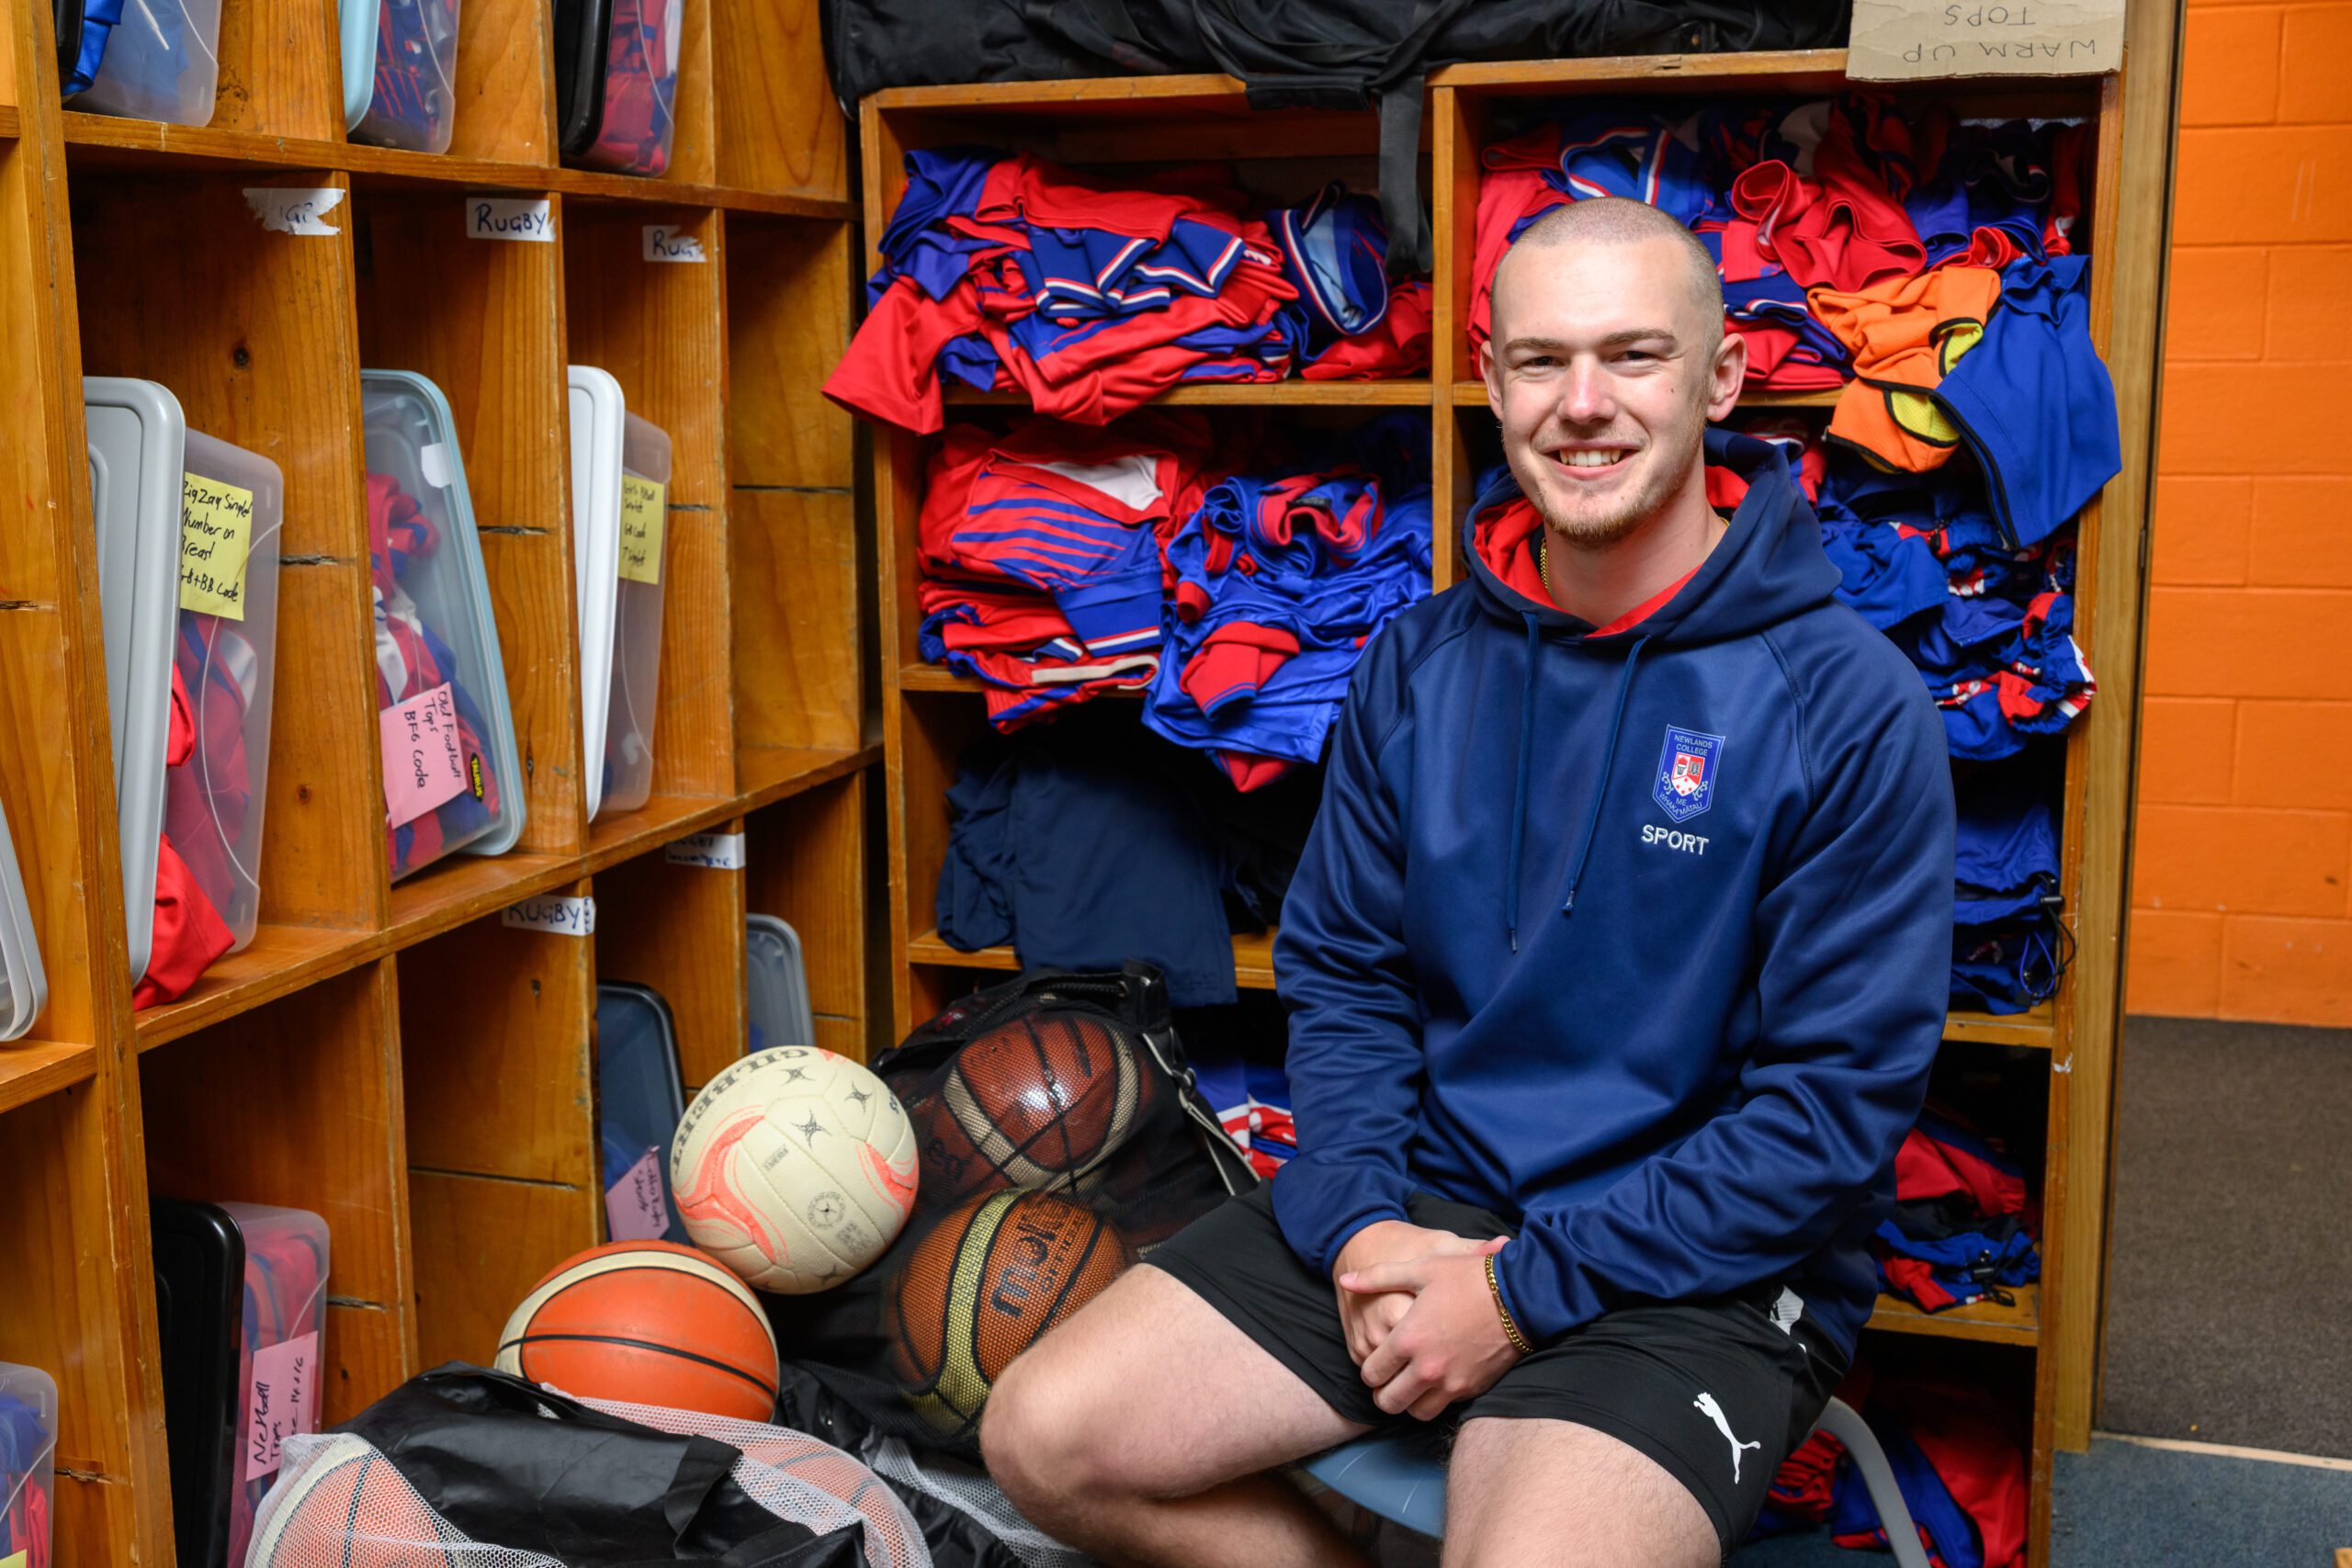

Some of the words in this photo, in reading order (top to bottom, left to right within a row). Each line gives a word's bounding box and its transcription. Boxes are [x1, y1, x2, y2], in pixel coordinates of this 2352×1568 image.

[1944, 6, 2036, 27] TOPS
[1903, 43, 1956, 63] UP
[1979, 39, 2096, 60] WARM
[183, 507, 222, 536] Number
[222, 529, 235, 540] on
[422, 697, 439, 733] Tops
[437, 691, 452, 717] Old
[1674, 735, 1713, 749] NEWLANDS
[1676, 743, 1709, 756] COLLEGE
[412, 750, 429, 789] Code
[470, 756, 484, 798] TAURUS
[1675, 797, 1688, 807] ME
[1640, 824, 1710, 855] SPORT
[673, 1048, 810, 1175] GILBERT
[253, 1381, 271, 1465] Netball
